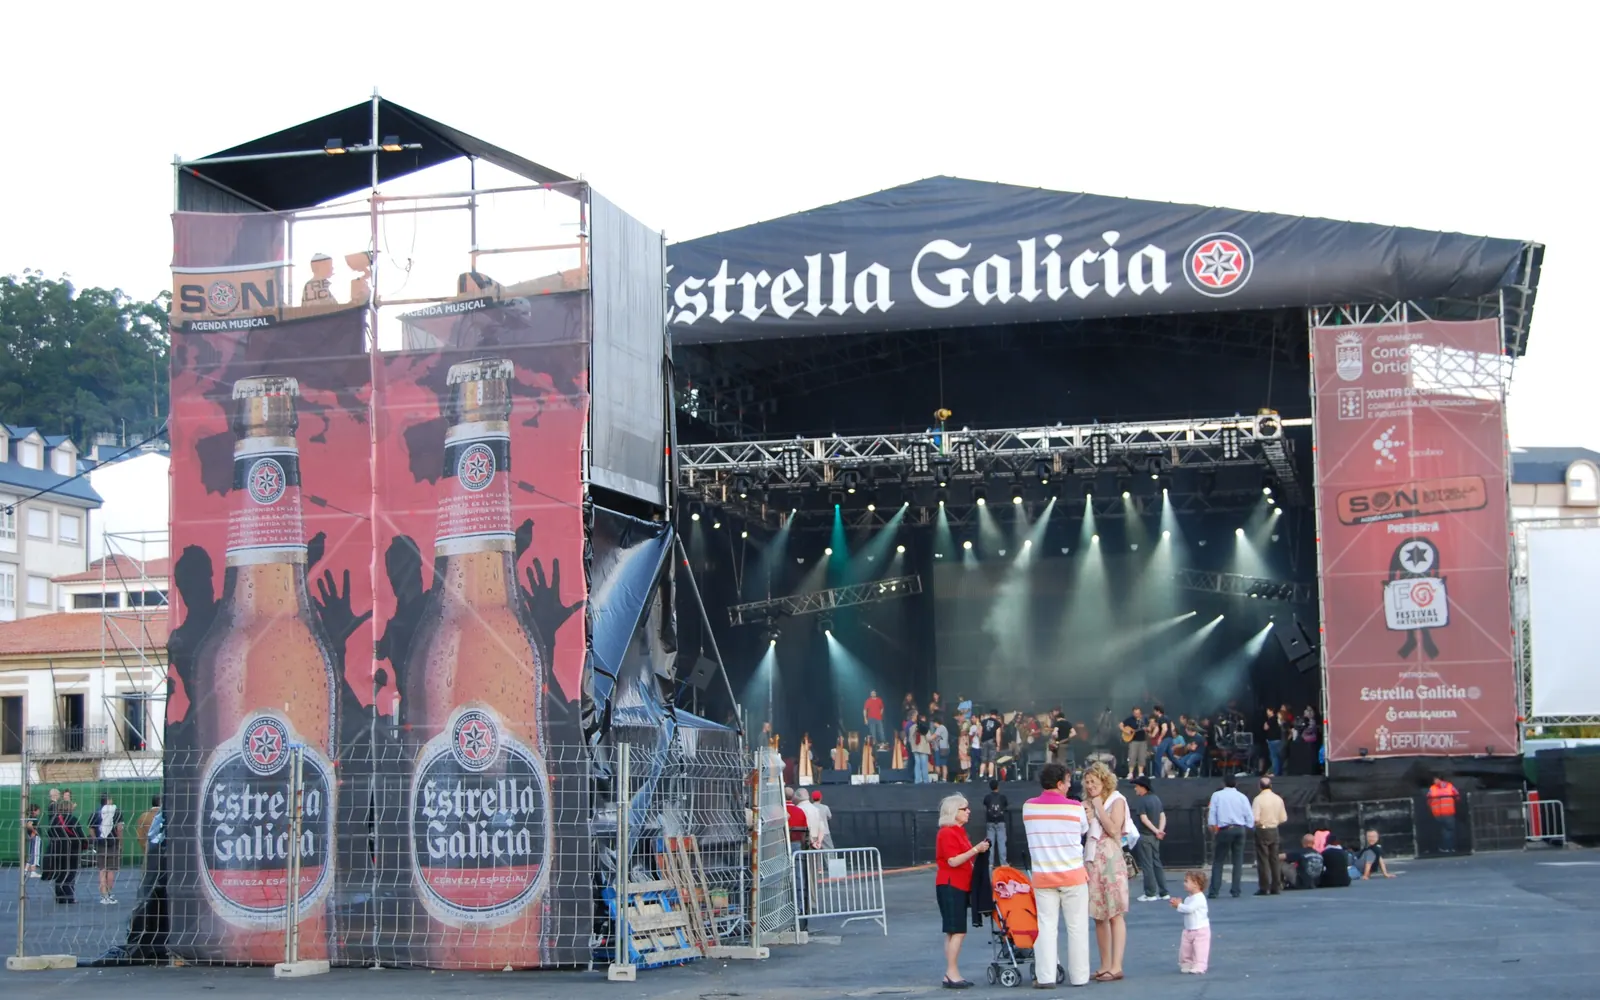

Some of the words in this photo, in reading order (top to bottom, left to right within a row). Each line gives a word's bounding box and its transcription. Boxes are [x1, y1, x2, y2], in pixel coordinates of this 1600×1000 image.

[667, 252, 896, 327] strella
[911, 231, 1171, 309] Galicia
[445, 299, 486, 313] MUSICAL
[191, 320, 227, 331] AGENDA
[229, 317, 269, 329] MUSICAL
[1367, 388, 1402, 399] XUNTA
[1396, 608, 1438, 619] FESTIVAL
[1360, 686, 1414, 701] Estrella
[1416, 684, 1466, 699] Galicia
[422, 779, 535, 819] Estrella
[426, 820, 533, 860] Galicia
[266, 876, 312, 886] ESPAL
[479, 876, 526, 884] ESPECIAL
